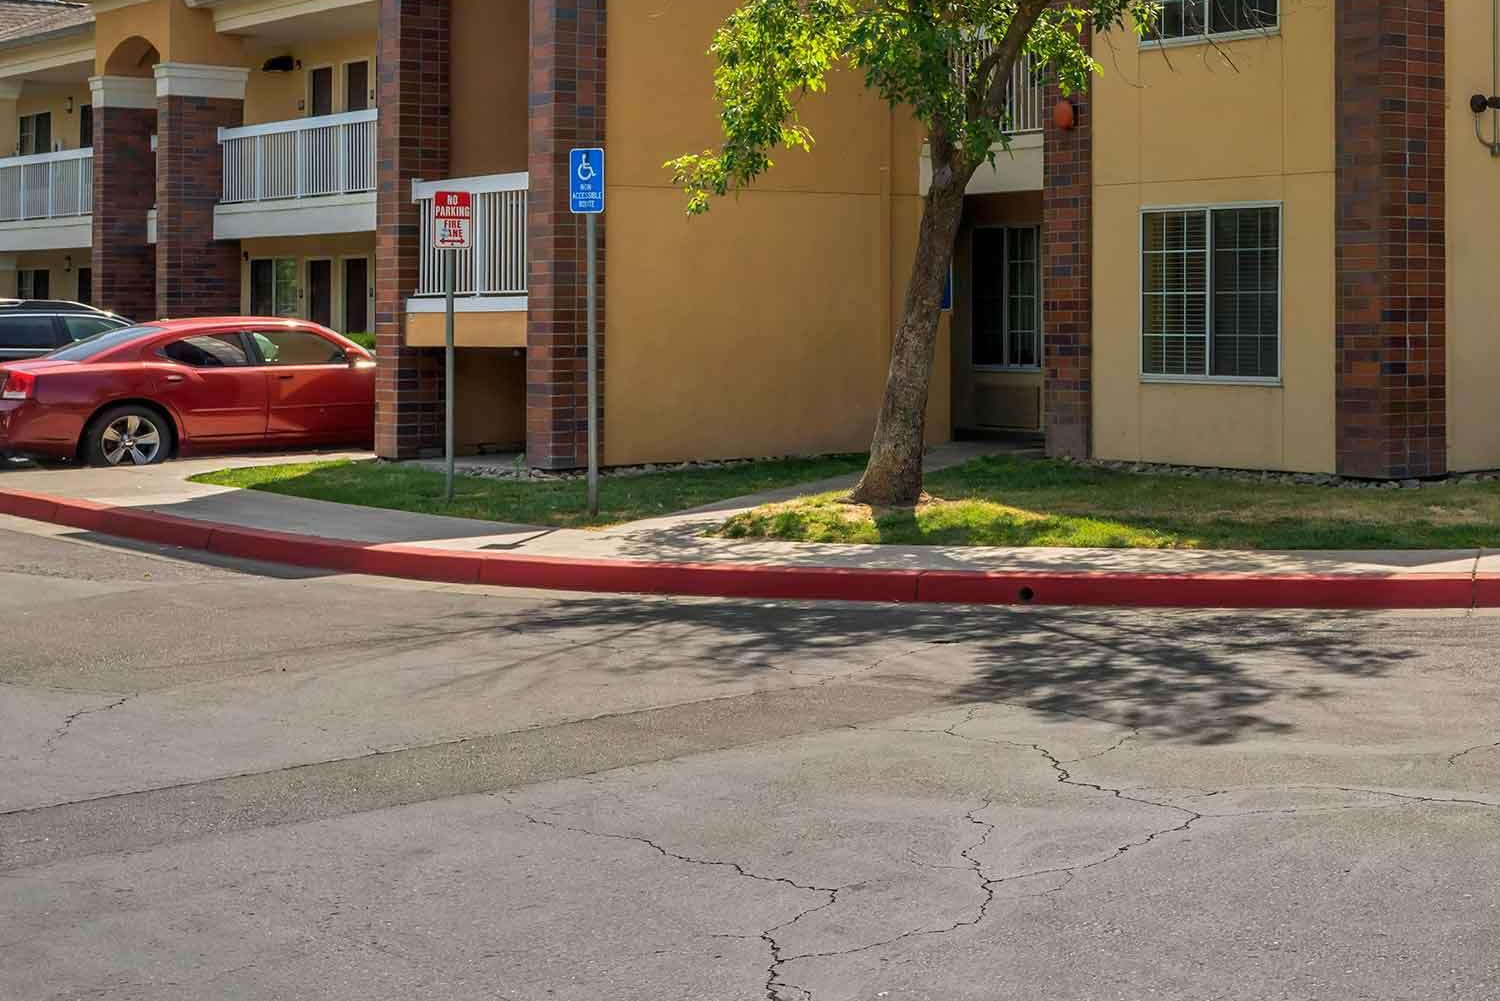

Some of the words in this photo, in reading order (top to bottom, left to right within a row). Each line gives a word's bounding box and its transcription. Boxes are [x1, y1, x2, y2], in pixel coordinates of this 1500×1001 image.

[447, 194, 458, 206] NO
[435, 206, 470, 217] PARKING
[443, 220, 462, 228] FIRE
[442, 229, 463, 238] ANE
